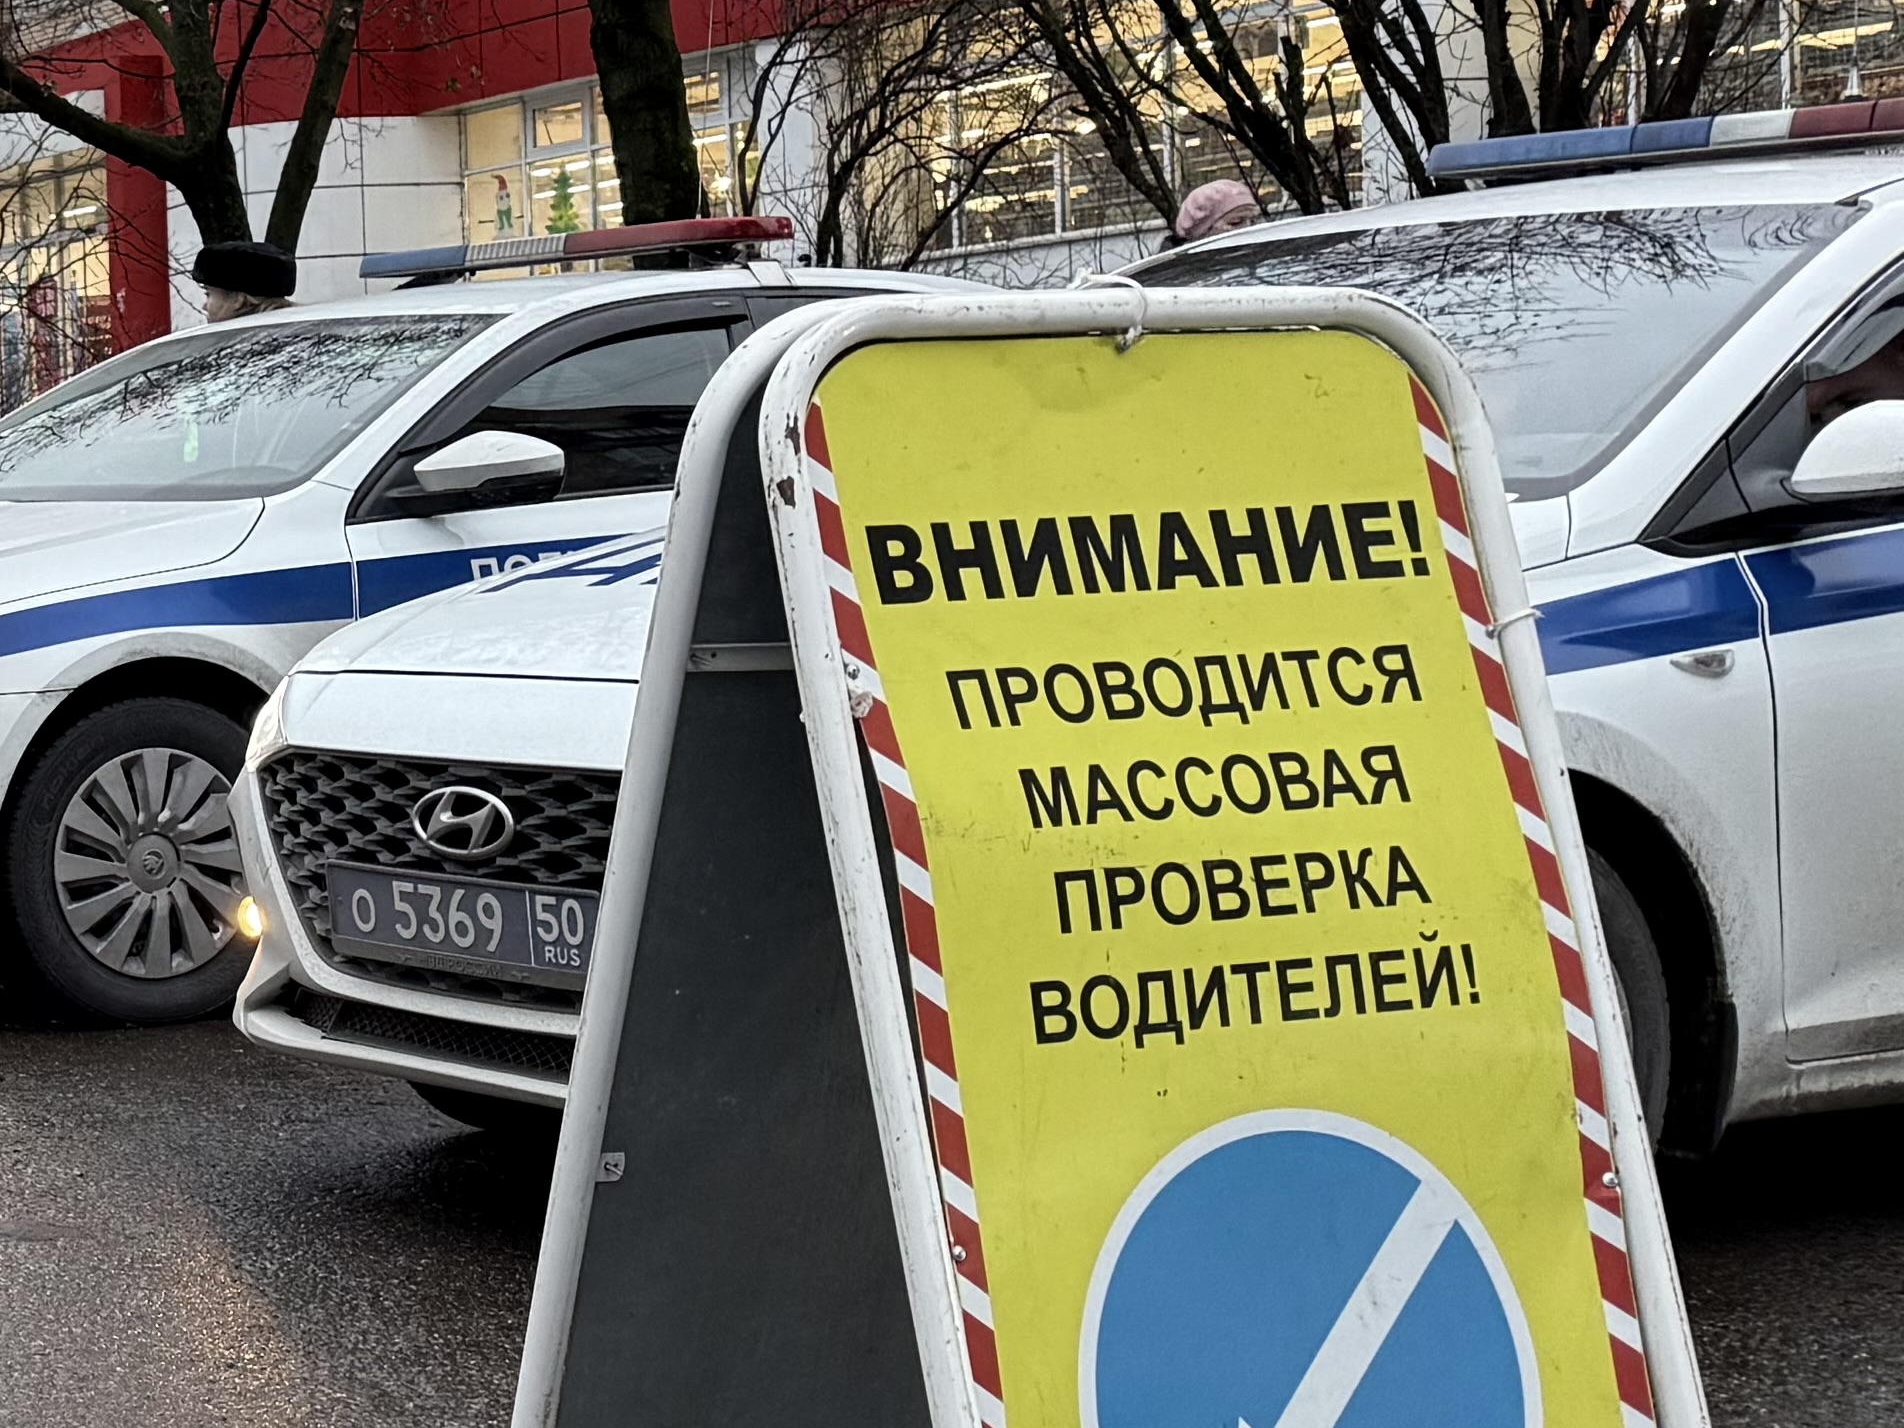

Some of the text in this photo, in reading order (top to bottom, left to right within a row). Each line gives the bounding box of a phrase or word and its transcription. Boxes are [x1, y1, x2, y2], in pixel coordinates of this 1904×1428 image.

[864, 499, 1430, 605] ВНИМАНИЕ!
[945, 644, 1423, 730] ПРОВОДИТСЯ
[1018, 744, 1411, 829] МАССОВАЯ
[391, 880, 503, 953] 5369
[535, 894, 585, 946] 50
[1053, 845, 1432, 934] ПРОВЕРКА
[544, 945, 582, 967] RUS
[1029, 930, 1481, 1049] ВОДИТЕЛЕЙ!
